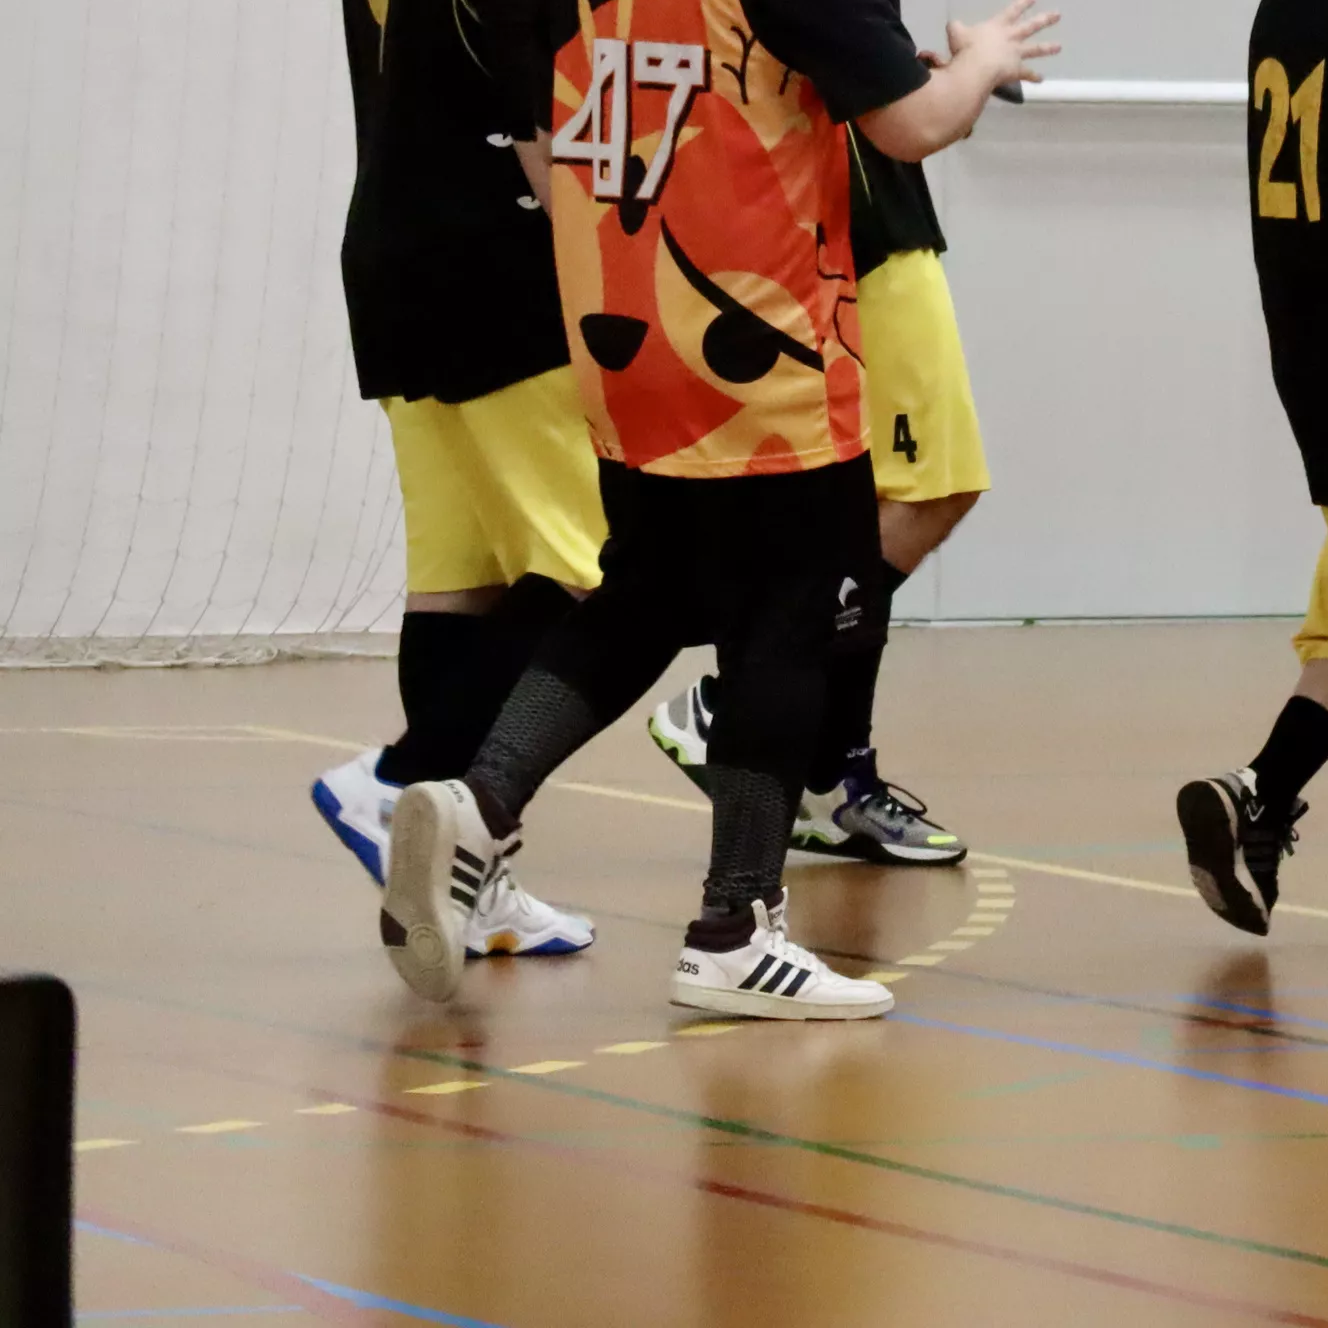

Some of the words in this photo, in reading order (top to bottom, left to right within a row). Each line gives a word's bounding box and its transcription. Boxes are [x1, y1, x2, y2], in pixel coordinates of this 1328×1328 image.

[552, 38, 708, 202] 47
[1254, 57, 1326, 223] 21
[893, 414, 918, 463] 4
